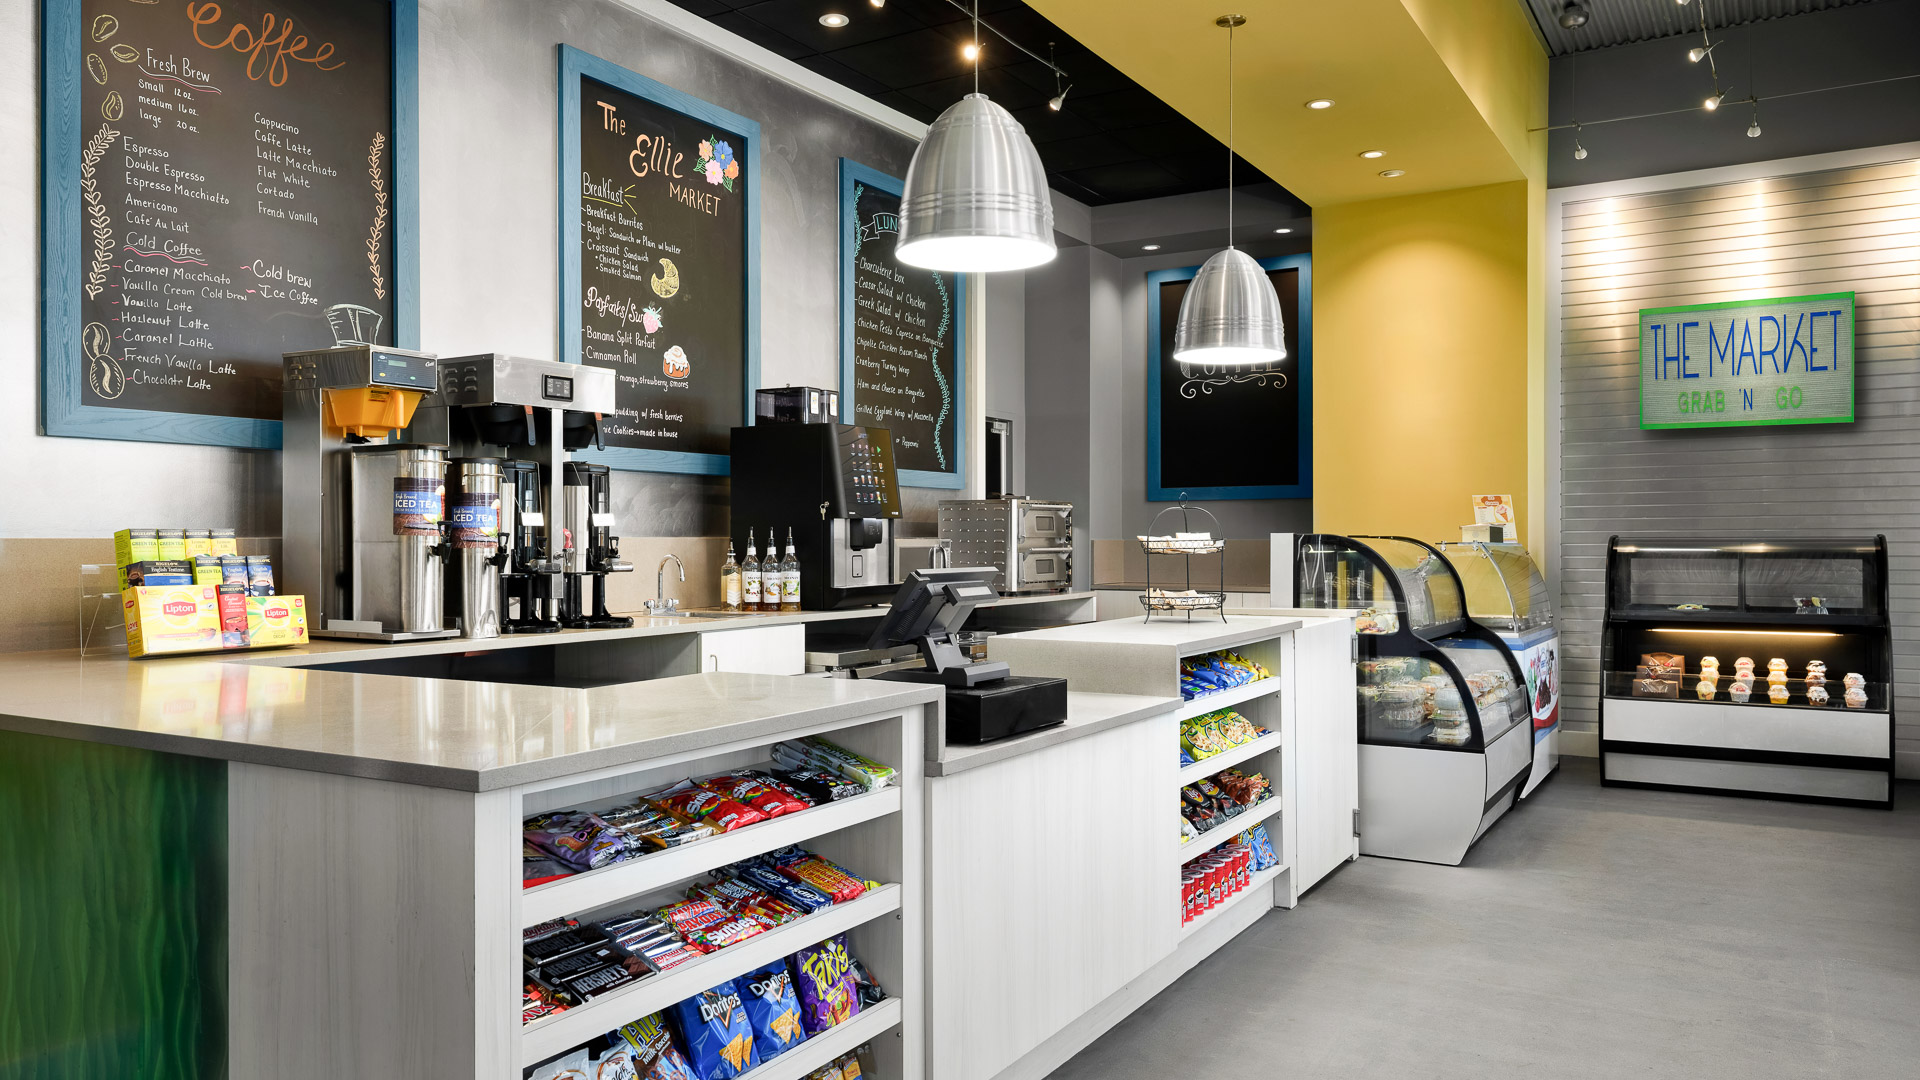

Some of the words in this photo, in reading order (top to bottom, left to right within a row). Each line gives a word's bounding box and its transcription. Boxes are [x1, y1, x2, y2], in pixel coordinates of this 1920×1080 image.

[187, 1, 346, 87] Coffee
[146, 47, 177, 74] Fresh
[182, 57, 211, 82] Brew
[138, 95, 173, 110] medium
[178, 103, 187, 113] 16
[174, 88, 181, 97] 12
[139, 108, 162, 128] large
[176, 120, 187, 129] 20
[254, 112, 300, 135] Cappucino
[596, 100, 626, 136] The
[123, 135, 169, 157] Espresso
[254, 129, 282, 148] Caffe
[286, 138, 312, 156] Latte
[256, 145, 281, 163] Latte
[285, 155, 337, 177] Macchiato
[629, 133, 684, 179] Ellie
[125, 155, 160, 173] Double
[164, 163, 205, 182] Espresso
[257, 165, 277, 179] Flat
[282, 171, 311, 188] White
[125, 171, 171, 192] Espresso
[256, 182, 295, 200] Cortado
[582, 171, 624, 204] Breakfast
[125, 192, 178, 214] Americano
[669, 181, 721, 217] MARKET
[258, 200, 285, 219] French
[288, 210, 319, 226] Vanilla
[586, 204, 616, 222] Breakfast
[618, 212, 644, 231] Burritos
[875, 215, 899, 232] LUN
[155, 218, 167, 230] Au
[171, 221, 189, 234] Lait
[126, 231, 156, 249] Cold
[163, 239, 203, 256] Coffee
[586, 238, 620, 256] Croissant
[623, 247, 649, 263] Sandwich
[608, 227, 635, 243] Sandwich
[642, 235, 656, 249] Plain
[664, 241, 682, 255] butter
[124, 259, 169, 277] Caramel
[173, 268, 231, 285] Macchiato
[252, 259, 283, 280] Cold
[287, 269, 312, 288] brew
[598, 253, 621, 267] Chicken
[622, 259, 639, 273] Salad
[599, 263, 621, 277] Smoked
[622, 268, 642, 282] Salmon
[122, 276, 158, 291] Vanilla
[163, 283, 195, 296] Cream
[201, 287, 223, 299] Cold
[894, 267, 905, 285] box
[121, 293, 159, 308] Vanilla
[166, 299, 194, 313] Latte
[258, 283, 286, 299] Ice
[289, 288, 318, 305] Coffee
[858, 276, 877, 290] Ceasar
[876, 281, 894, 298] Salad
[905, 293, 926, 311] Chicken
[178, 315, 210, 330] Latte
[857, 294, 875, 310] Greek
[875, 300, 892, 316] Salad
[904, 312, 926, 328] Chicken
[122, 327, 173, 344] Caramel
[586, 325, 615, 343] Banana
[616, 330, 633, 347] Split
[635, 332, 656, 350] Parfait
[857, 316, 879, 332] Chicken
[879, 320, 893, 335] Pesto
[895, 326, 914, 340] Caprese
[586, 345, 622, 363] Cinnamon
[623, 349, 637, 365] Roll
[856, 336, 877, 351] Chipotle
[878, 340, 898, 354] Chicken
[899, 346, 914, 357] Bacon
[914, 349, 928, 361] Ranch
[1650, 321, 1700, 380] THE
[1709, 310, 1842, 378] MARKET
[123, 347, 161, 365] French
[164, 353, 202, 371] Vanilla
[208, 359, 237, 375] Latte
[855, 355, 880, 376] Cranberry
[881, 359, 897, 378] Turkey
[898, 364, 910, 377] Wrap
[132, 368, 183, 385] Chocolate
[186, 375, 211, 390] Latte
[857, 378, 869, 389] Ham
[870, 382, 880, 391] and
[881, 382, 896, 394] Cheese
[1677, 389, 1726, 414] GRAB
[1738, 388, 1753, 411] 'N
[1775, 385, 1803, 410] GO
[615, 407, 639, 423] pudding
[649, 409, 664, 420] fresh
[664, 410, 683, 422] berries
[856, 403, 873, 415] Grilled
[873, 405, 893, 421] Eggplant
[894, 408, 905, 421] Wrap
[613, 424, 634, 435] Cookies
[640, 429, 656, 437] made
[657, 429, 663, 437] in
[663, 427, 678, 438] house
[395, 499, 416, 508] ICED
[419, 500, 438, 508] TEA
[453, 514, 473, 522] ICED
[476, 514, 494, 522] TEA
[166, 604, 193, 614] Lipton
[266, 609, 287, 617] Lipton
[668, 900, 713, 922] PAYDAY
[677, 911, 724, 932] PAYDAY
[706, 917, 757, 945] Skittles
[526, 932, 580, 956] HERSHEY'S
[543, 952, 599, 976] HERSHEY'S
[571, 964, 629, 994] HERSHEY'S
[749, 969, 790, 998] Doritos
[700, 992, 741, 1022] Doritos
